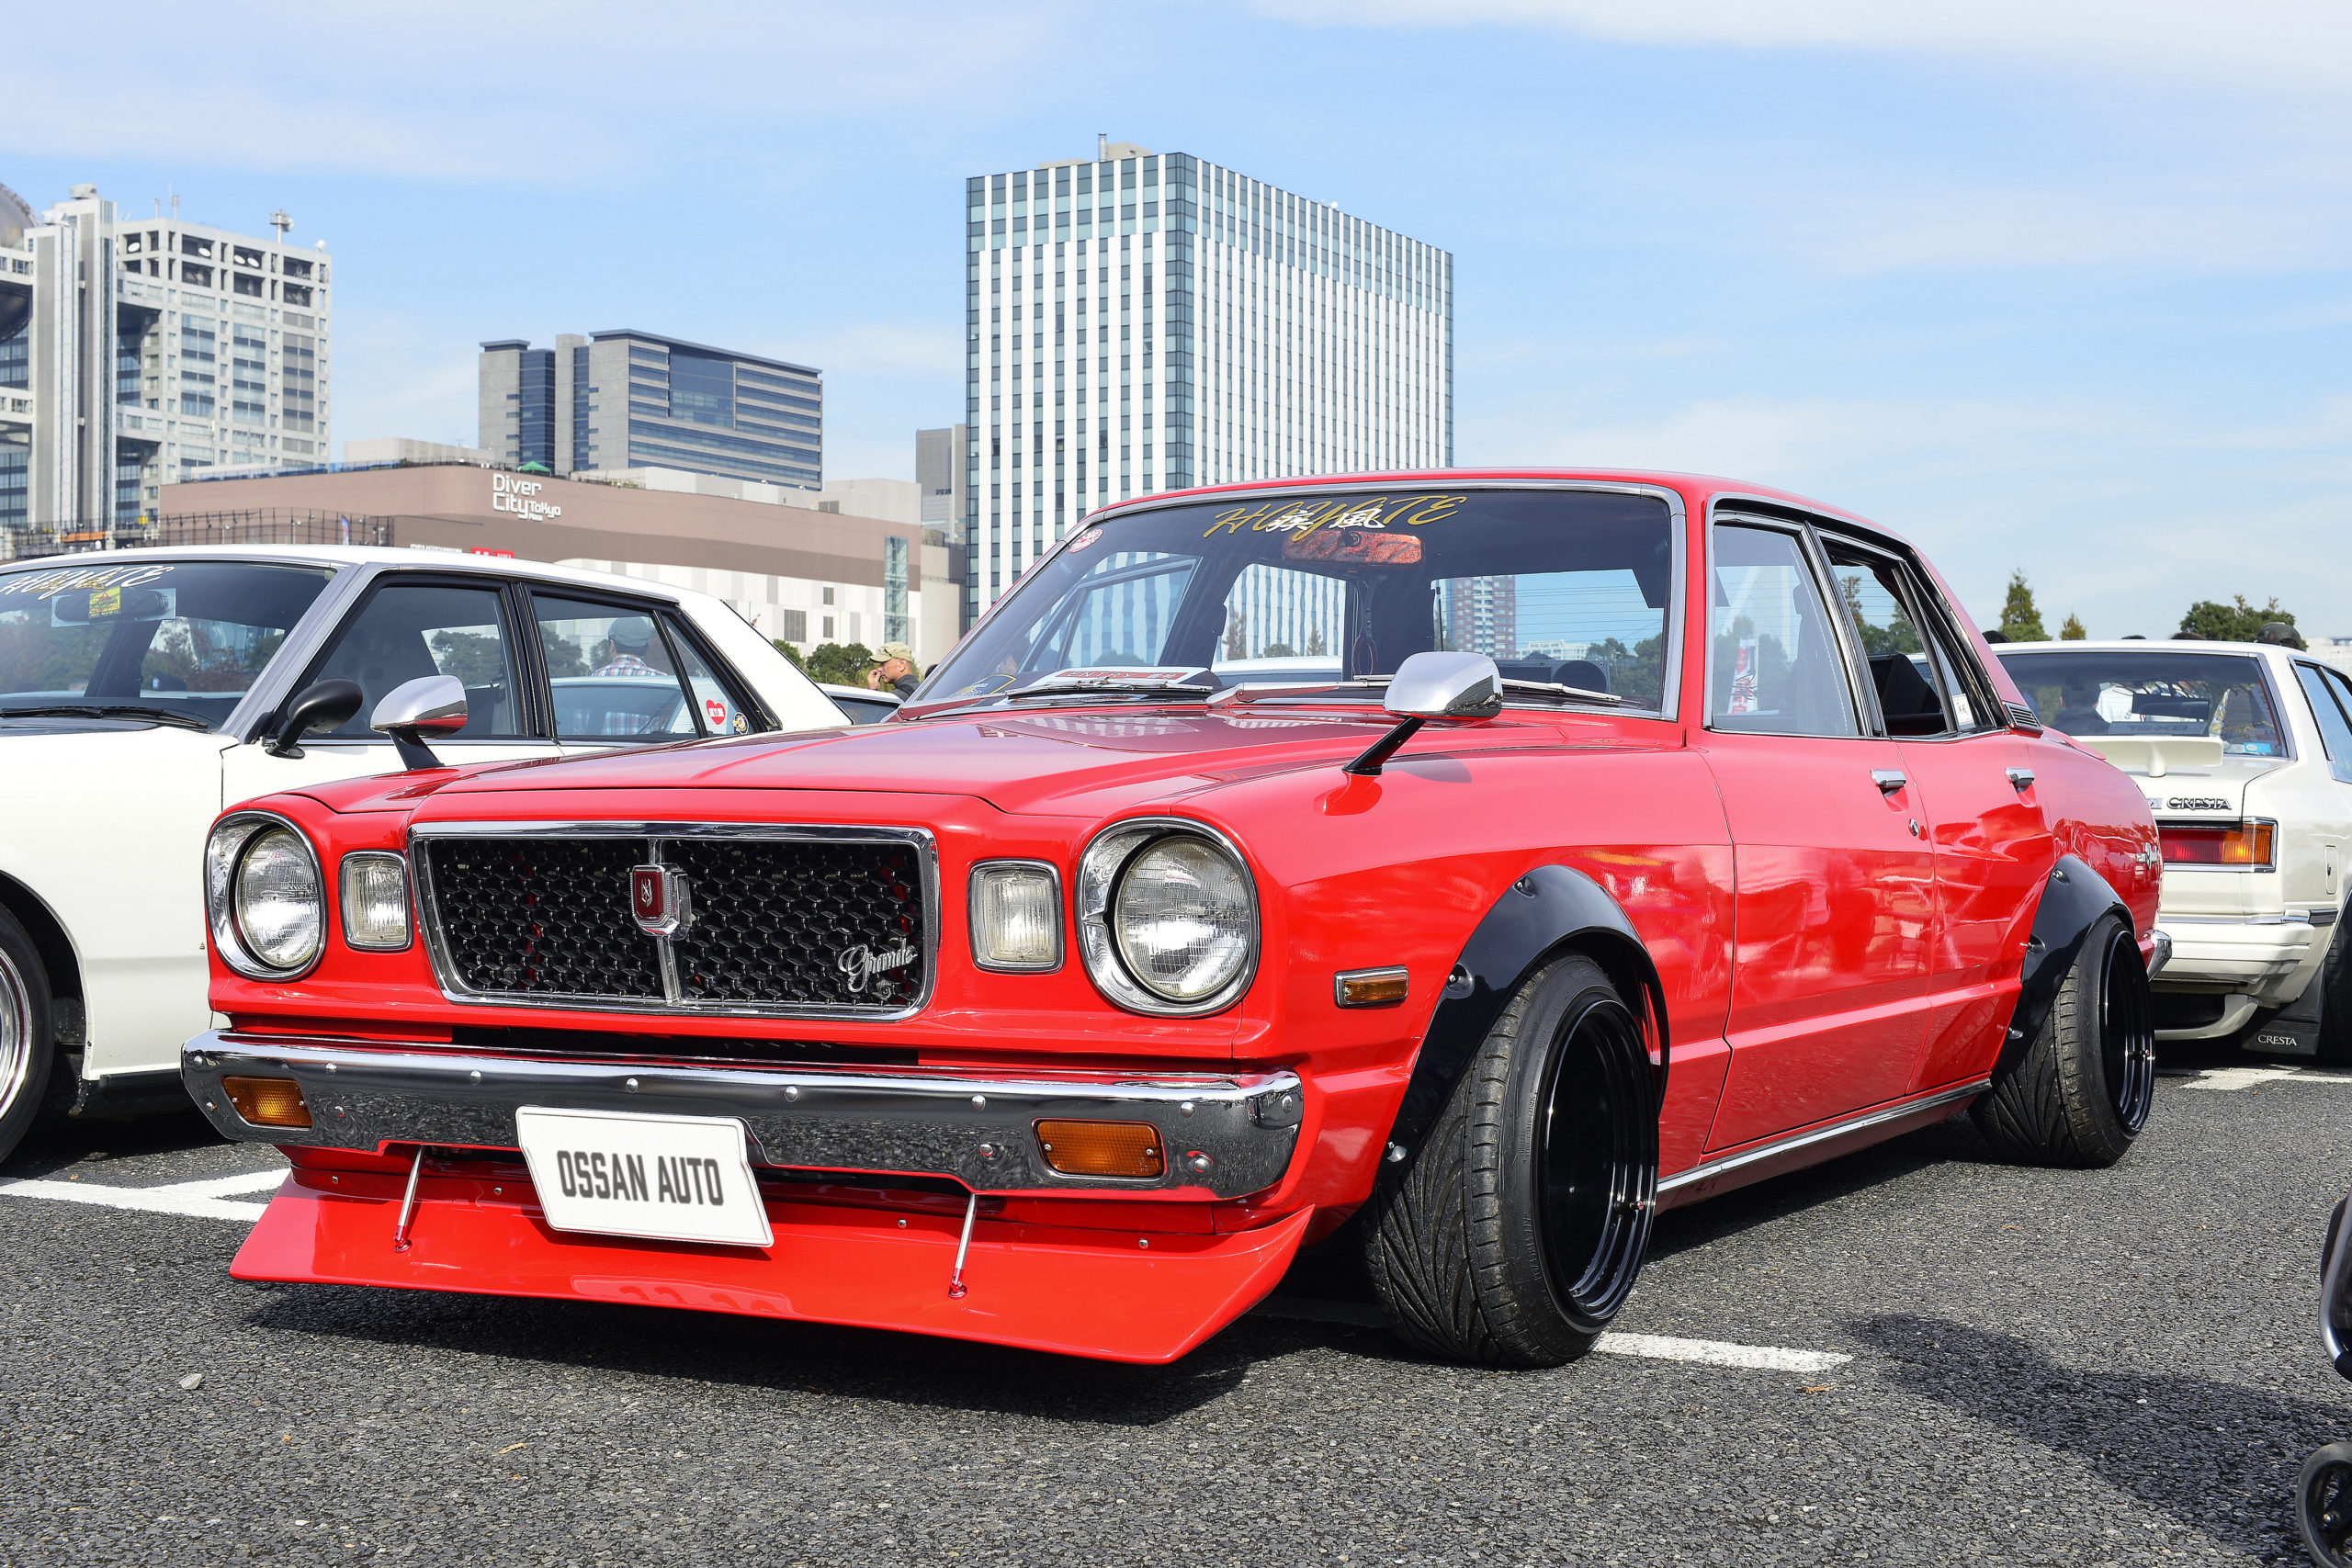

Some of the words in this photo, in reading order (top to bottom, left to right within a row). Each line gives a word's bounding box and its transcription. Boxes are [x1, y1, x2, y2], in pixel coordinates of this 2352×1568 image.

[492, 473, 542, 496] Diver
[492, 491, 529, 520] City
[1203, 495, 1466, 542] HAYATE
[1066, 671, 1136, 679] ENTRY
[2166, 797, 2233, 810] CRESTA
[837, 937, 918, 993] Grande
[2257, 1034, 2298, 1046] CRESTA
[556, 1150, 650, 1202] OSSAN
[657, 1155, 724, 1206] AUTO
